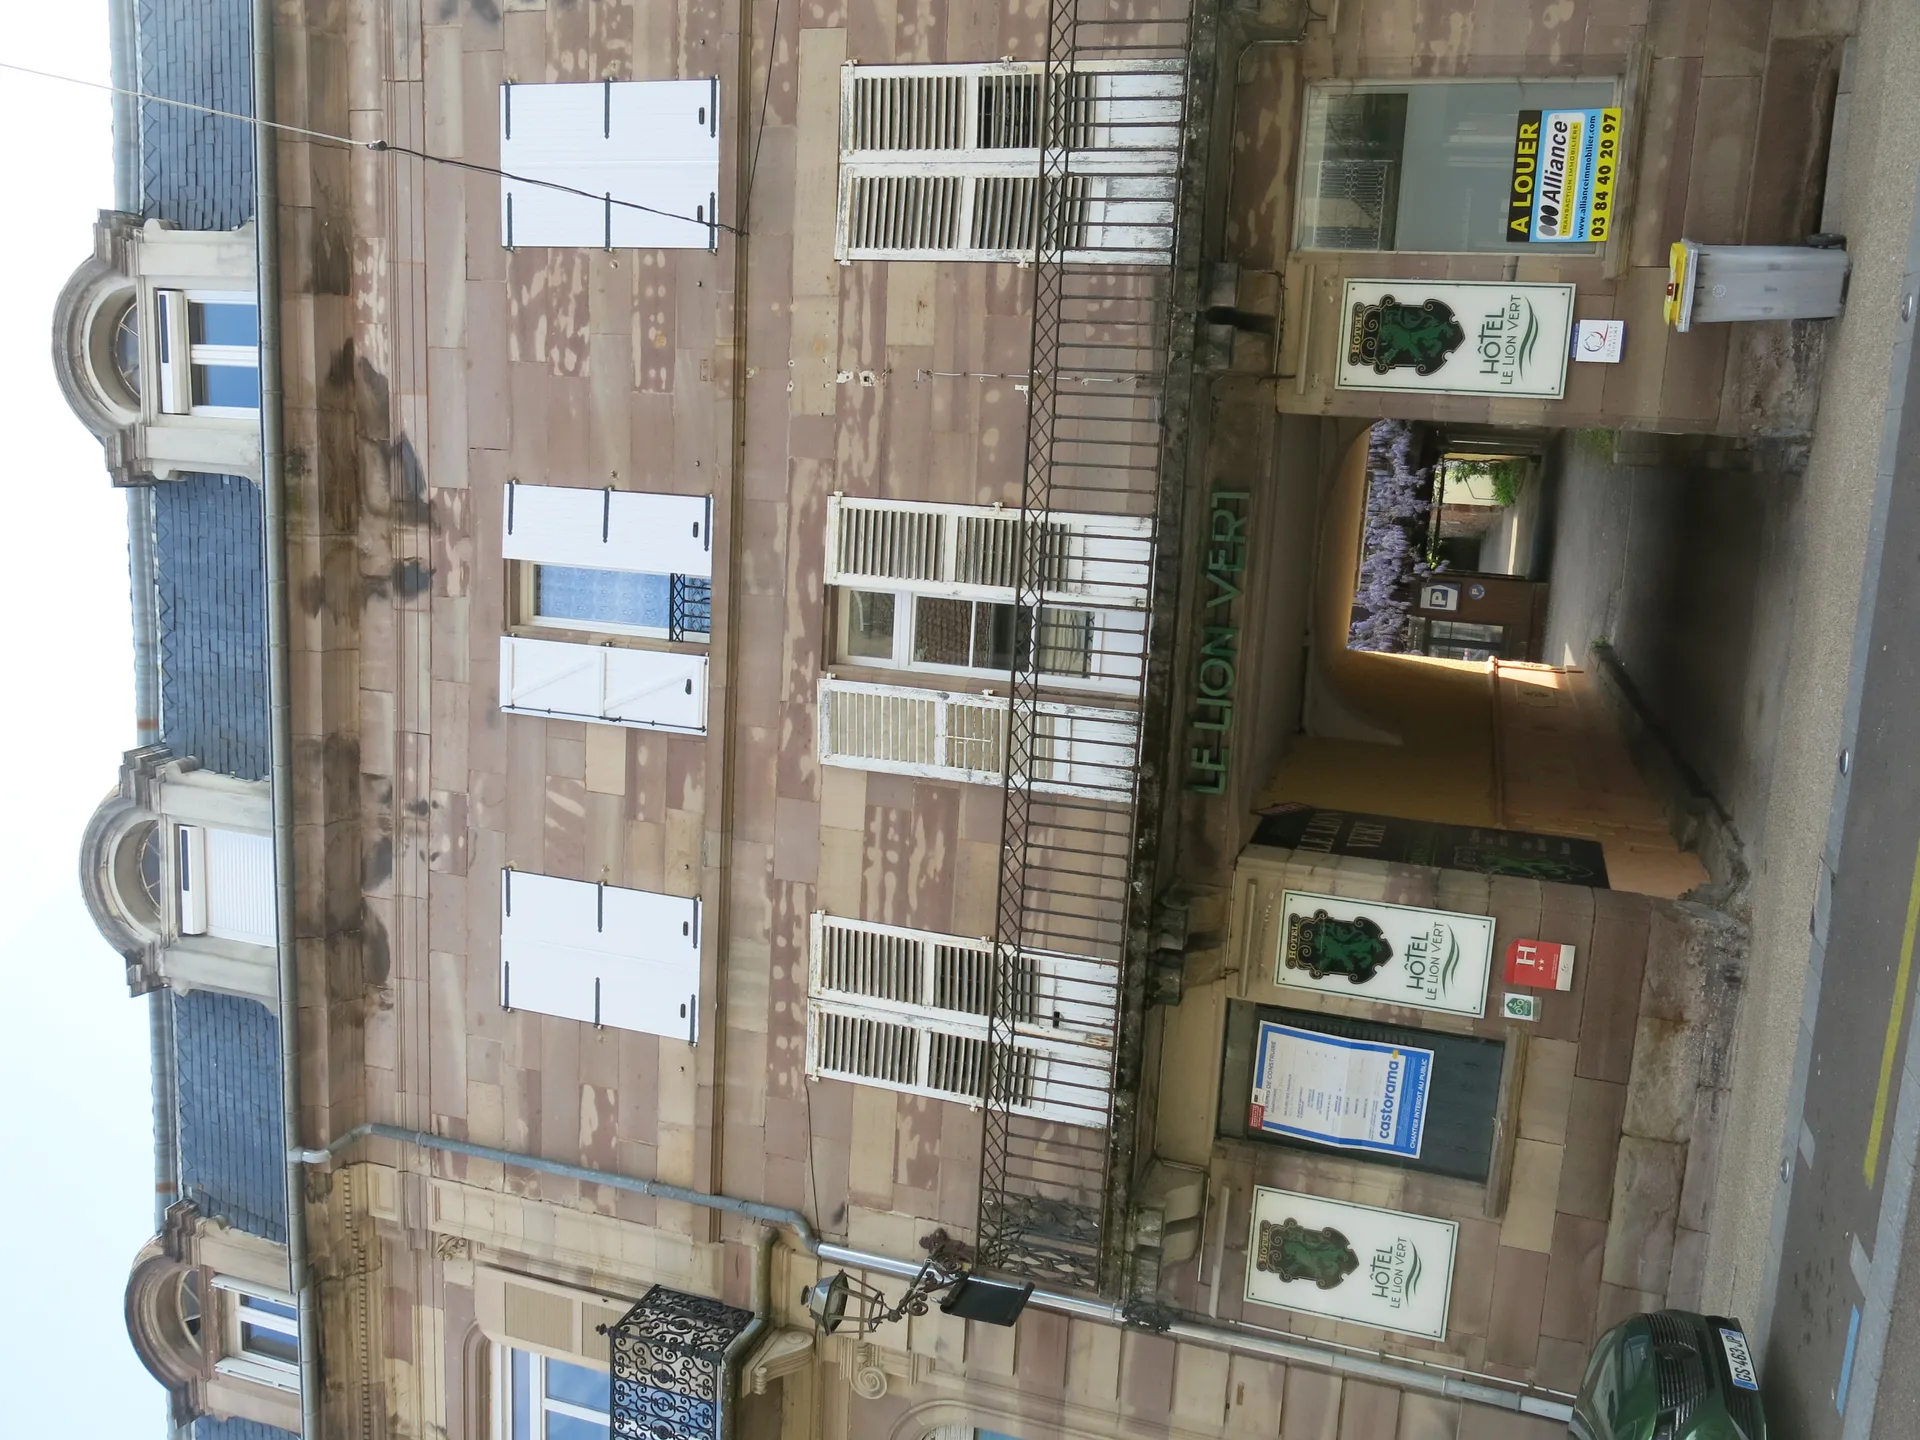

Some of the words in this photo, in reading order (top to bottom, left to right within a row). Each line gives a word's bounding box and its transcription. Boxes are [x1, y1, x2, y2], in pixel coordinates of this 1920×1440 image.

[1602, 113, 1616, 134] 97
[1542, 120, 1568, 204] Alliance
[1600, 140, 1614, 158] 20
[1512, 122, 1538, 207] LOUER
[1562, 180, 1572, 234] TRANSACTION
[1567, 124, 1578, 176] IMMOBILIÈRE
[1578, 115, 1596, 238] www.allianceimmobilier.com
[1597, 166, 1611, 185] 40
[1594, 191, 1608, 210] 84
[1511, 216, 1530, 233] A
[1591, 217, 1606, 236] 03
[1506, 294, 1522, 330] VERT
[1351, 312, 1362, 354] HOTEL
[1476, 308, 1505, 374] HÔTEL
[1502, 336, 1516, 366] LION
[1500, 371, 1514, 384] LE
[1205, 492, 1250, 608] VERT
[1431, 592, 1446, 605] P
[1193, 626, 1240, 731] LION
[1184, 748, 1230, 794] LE
[1296, 834, 1334, 852] LE
[1346, 820, 1386, 848] VERT
[1288, 923, 1298, 959] HOTEL
[1431, 922, 1444, 952] VERT
[1404, 932, 1429, 990] HÔTEL
[1426, 957, 1440, 984] LION
[1516, 944, 1537, 968] H
[1425, 988, 1438, 1000] LE
[1267, 1040, 1276, 1080] CONSTRUIRE
[1419, 1058, 1428, 1080] PUBLIC
[1266, 1080, 1272, 1089] DE
[1418, 1080, 1425, 1090] AU
[1379, 1061, 1399, 1139] castorama
[1414, 1091, 1424, 1118] INTERDIT
[1410, 1118, 1420, 1148] CHANTIER
[1259, 1229, 1270, 1262] HOTEL
[1394, 1236, 1407, 1265] VERT
[1370, 1246, 1393, 1298] HÔTEL
[1392, 1268, 1404, 1294] LION
[1390, 1296, 1401, 1308] LE
[1725, 1336, 1752, 1382] GS-463-JP
